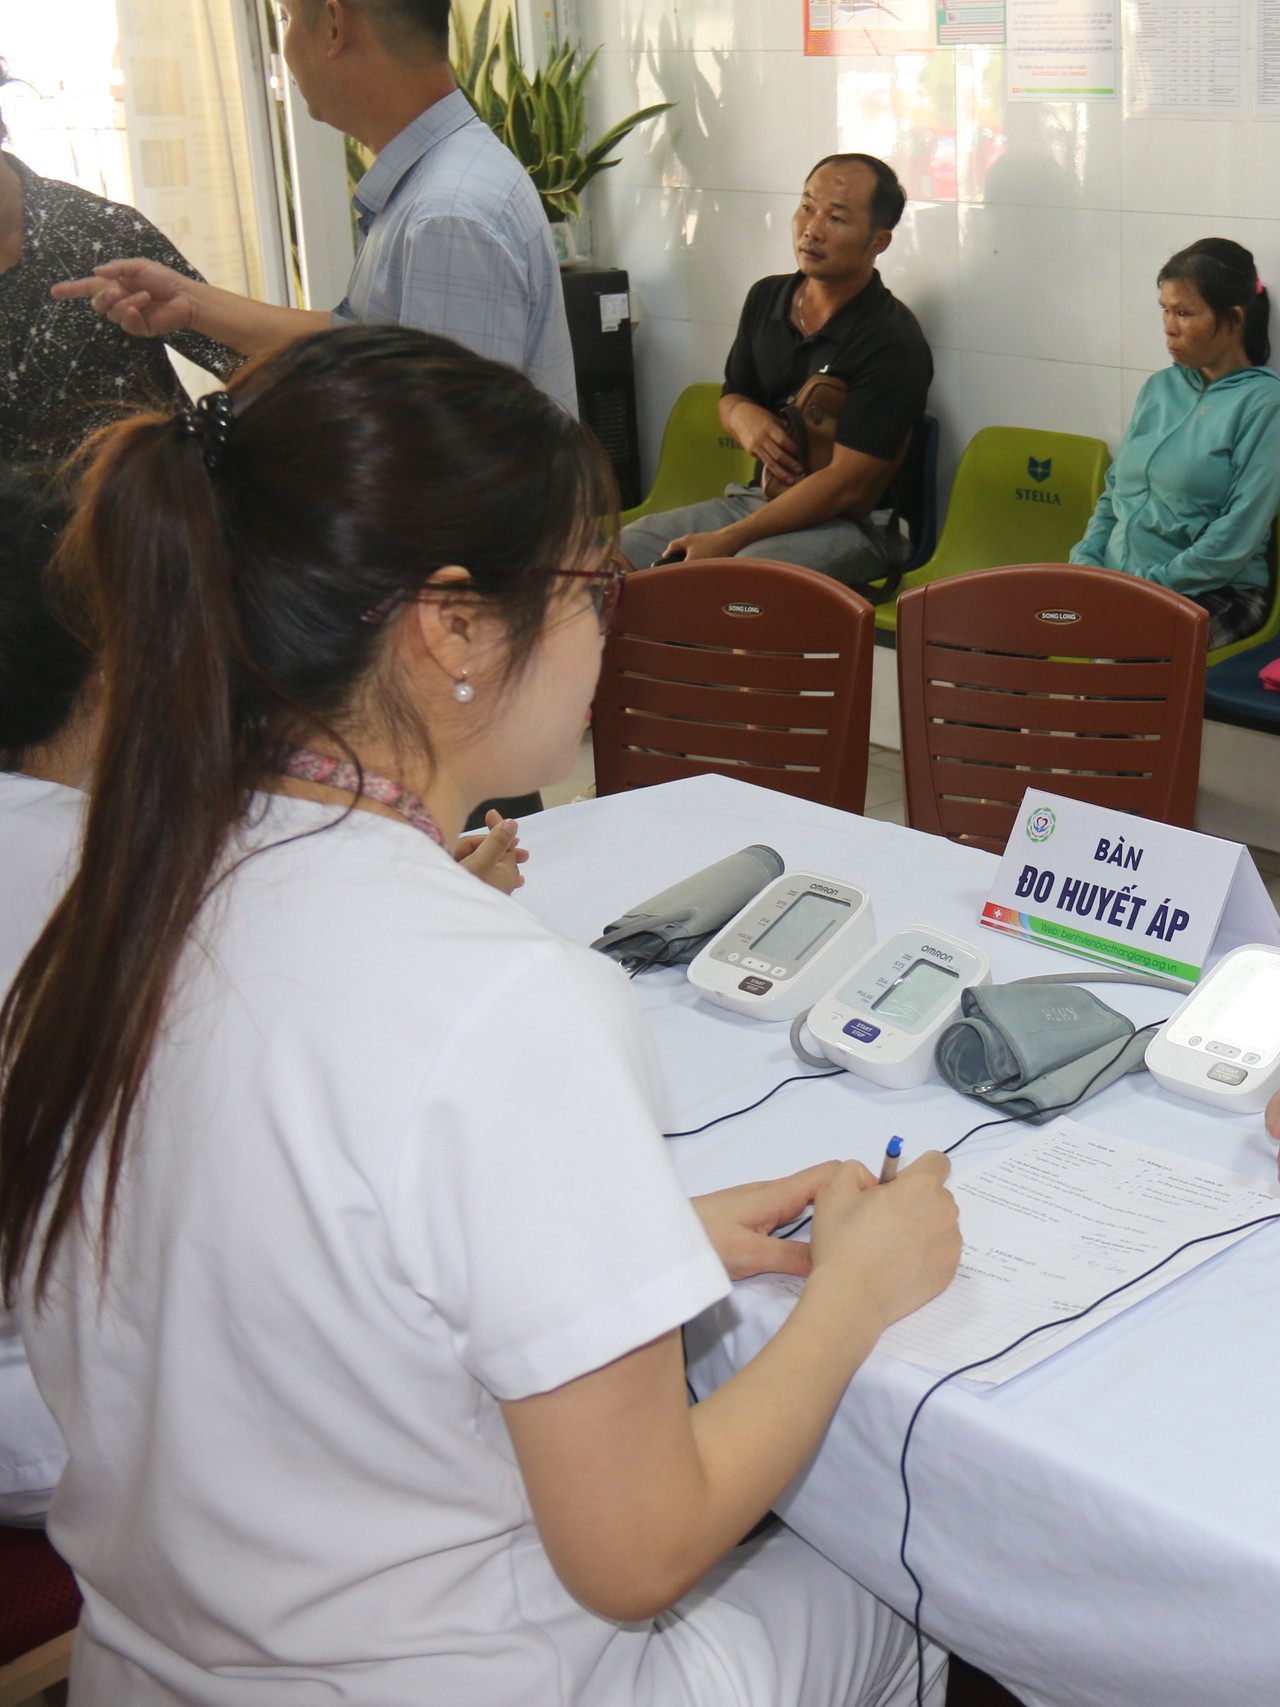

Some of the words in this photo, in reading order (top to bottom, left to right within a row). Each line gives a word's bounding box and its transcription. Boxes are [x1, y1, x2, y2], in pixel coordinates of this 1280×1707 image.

[1015, 487, 1061, 506] STELLA
[728, 604, 744, 612] SONG
[1094, 836, 1144, 871] BÀN
[810, 883, 839, 896] OMRON
[1014, 864, 1055, 903] ĐO
[1056, 876, 1148, 931] HUYẾT
[1144, 898, 1190, 943] ÁP
[1040, 922, 1061, 936] Web:
[921, 944, 953, 963] OMRON
[894, 960, 906, 969] SYS
[851, 1029, 866, 1038] STOP
[856, 1022, 873, 1032] START
